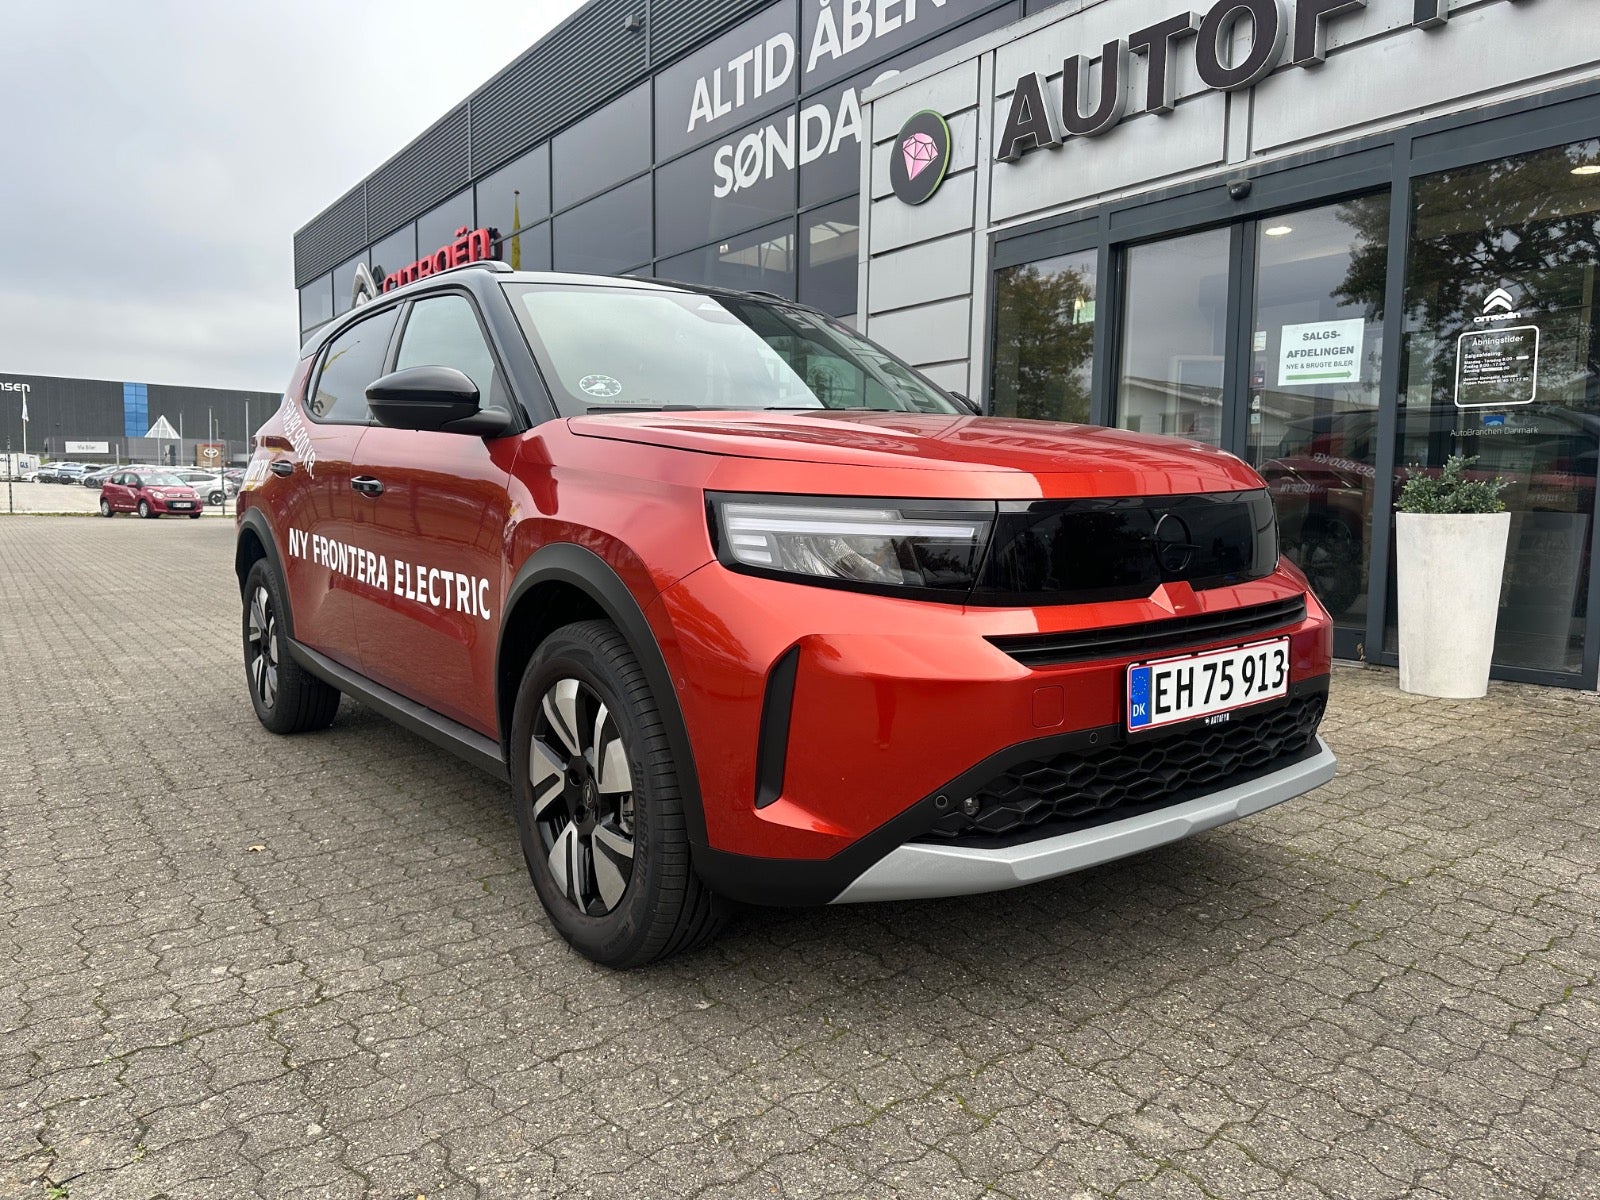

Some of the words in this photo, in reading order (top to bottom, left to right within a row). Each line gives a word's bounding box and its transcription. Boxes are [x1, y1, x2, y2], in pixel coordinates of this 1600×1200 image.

[686, 32, 796, 134] ALTID
[995, 0, 1541, 163] AUTOF
[713, 69, 901, 199] SØNDA
[1303, 331, 1340, 341] SALGS-
[1472, 335, 1524, 347] Åbningstider
[1287, 346, 1354, 358] AFDELINGEN
[1306, 361, 1333, 369] BRUGTE
[1449, 427, 1502, 437] AutoBranchen
[1504, 426, 1539, 435] Danmark
[289, 527, 309, 560] NY
[312, 533, 388, 591] FRONTERA
[393, 559, 491, 621] ELECTRIC
[1155, 666, 1194, 715] EH
[1202, 659, 1234, 705] 75
[1241, 649, 1286, 697] 913
[1132, 702, 1146, 717] DK
